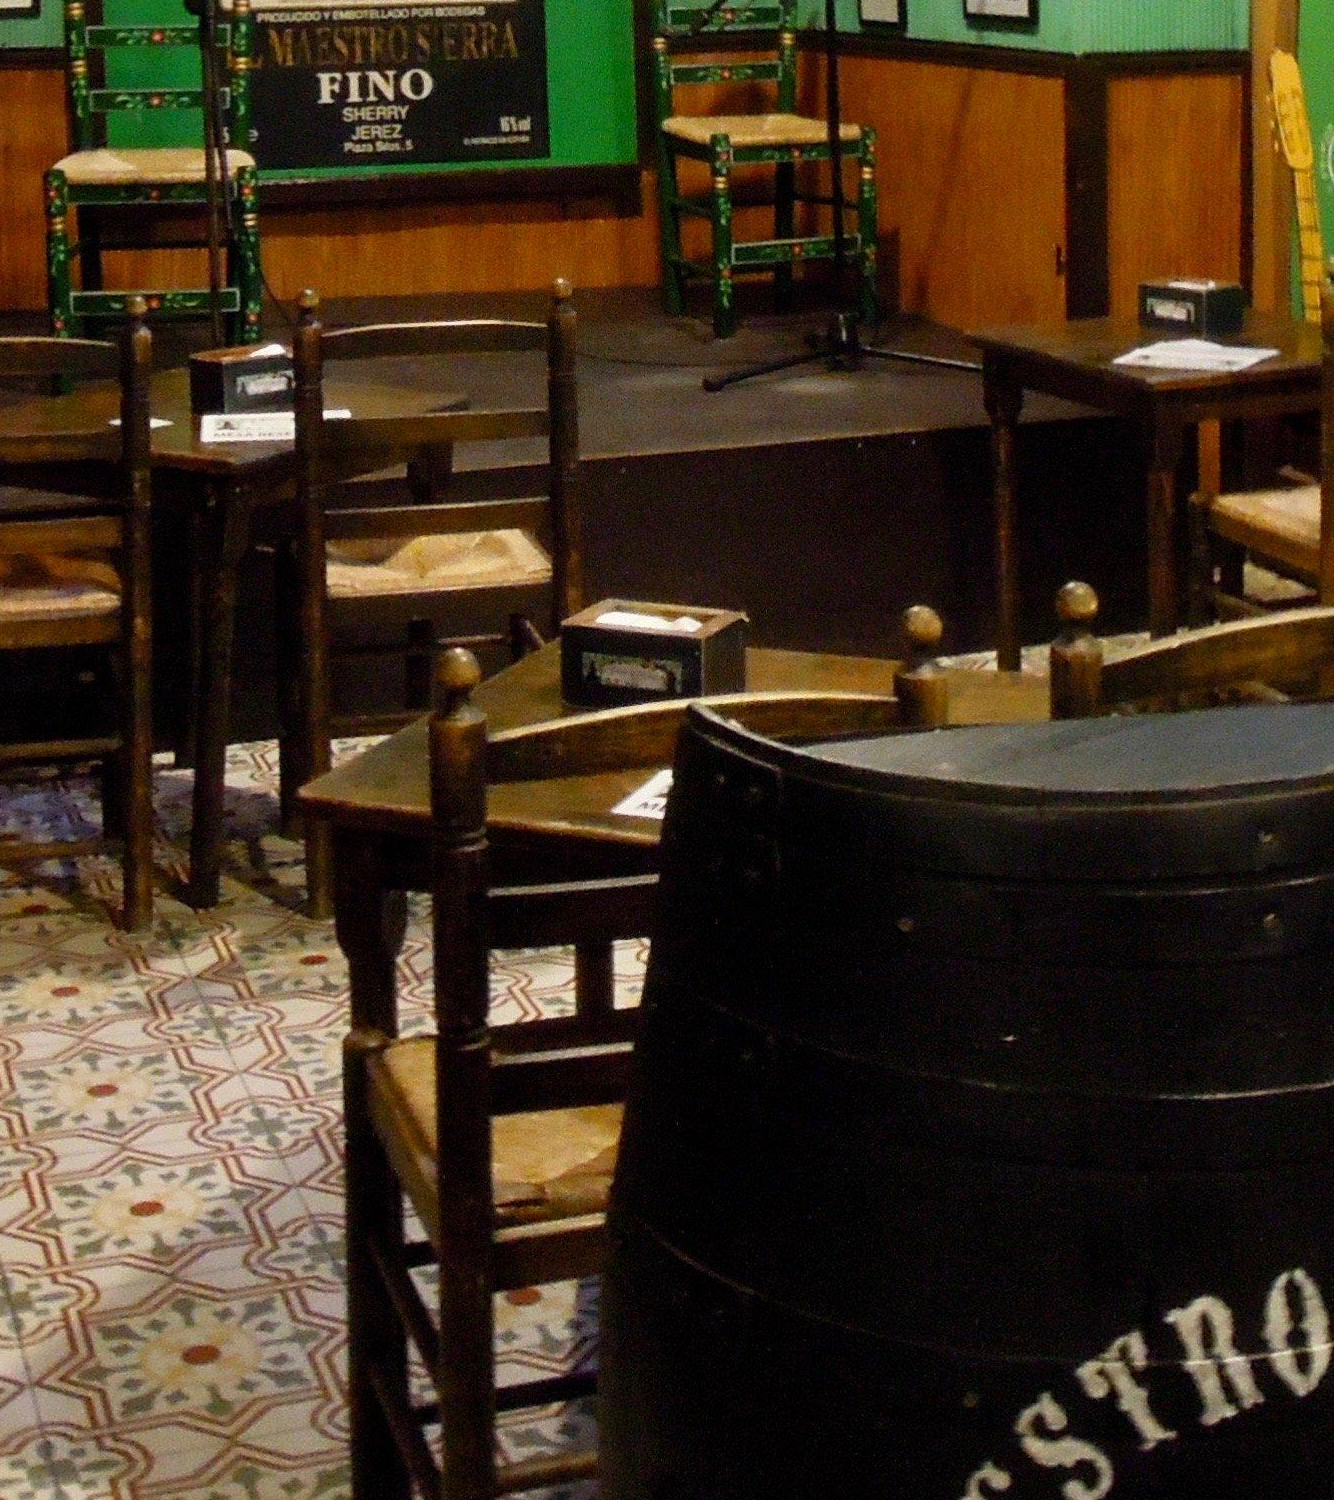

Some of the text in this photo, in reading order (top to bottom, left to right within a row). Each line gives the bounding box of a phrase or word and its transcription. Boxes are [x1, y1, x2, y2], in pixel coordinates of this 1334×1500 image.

[411, 7, 433, 18] POR
[435, 6, 486, 18] BODEGAS
[270, 26, 408, 66] MAESTRO
[317, 68, 433, 104] FINO
[342, 105, 409, 122] SHERRY
[351, 124, 403, 140] JEREZ
